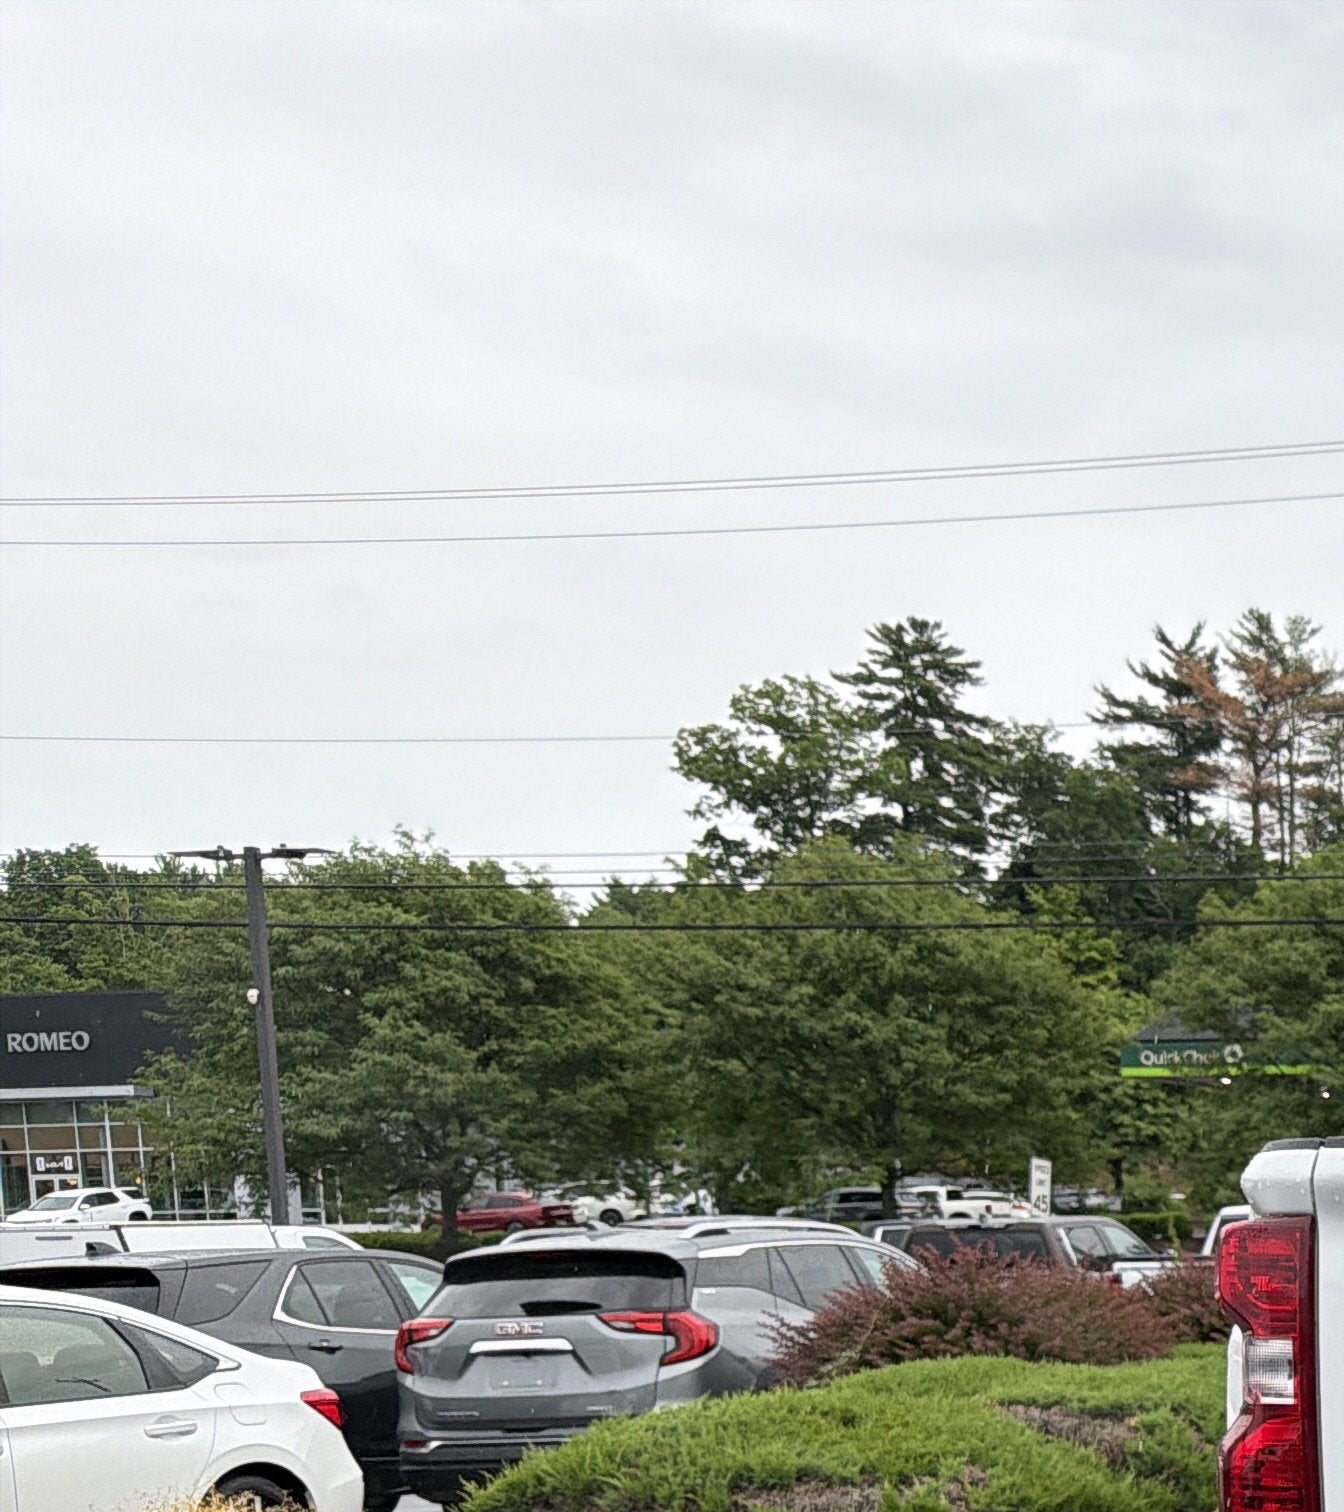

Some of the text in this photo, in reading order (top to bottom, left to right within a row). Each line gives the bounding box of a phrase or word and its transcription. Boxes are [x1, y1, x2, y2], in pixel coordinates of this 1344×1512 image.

[6, 1031, 90, 1053] ROMEO
[1034, 1194, 1049, 1213] 45
[495, 1321, 544, 1336] GMC
